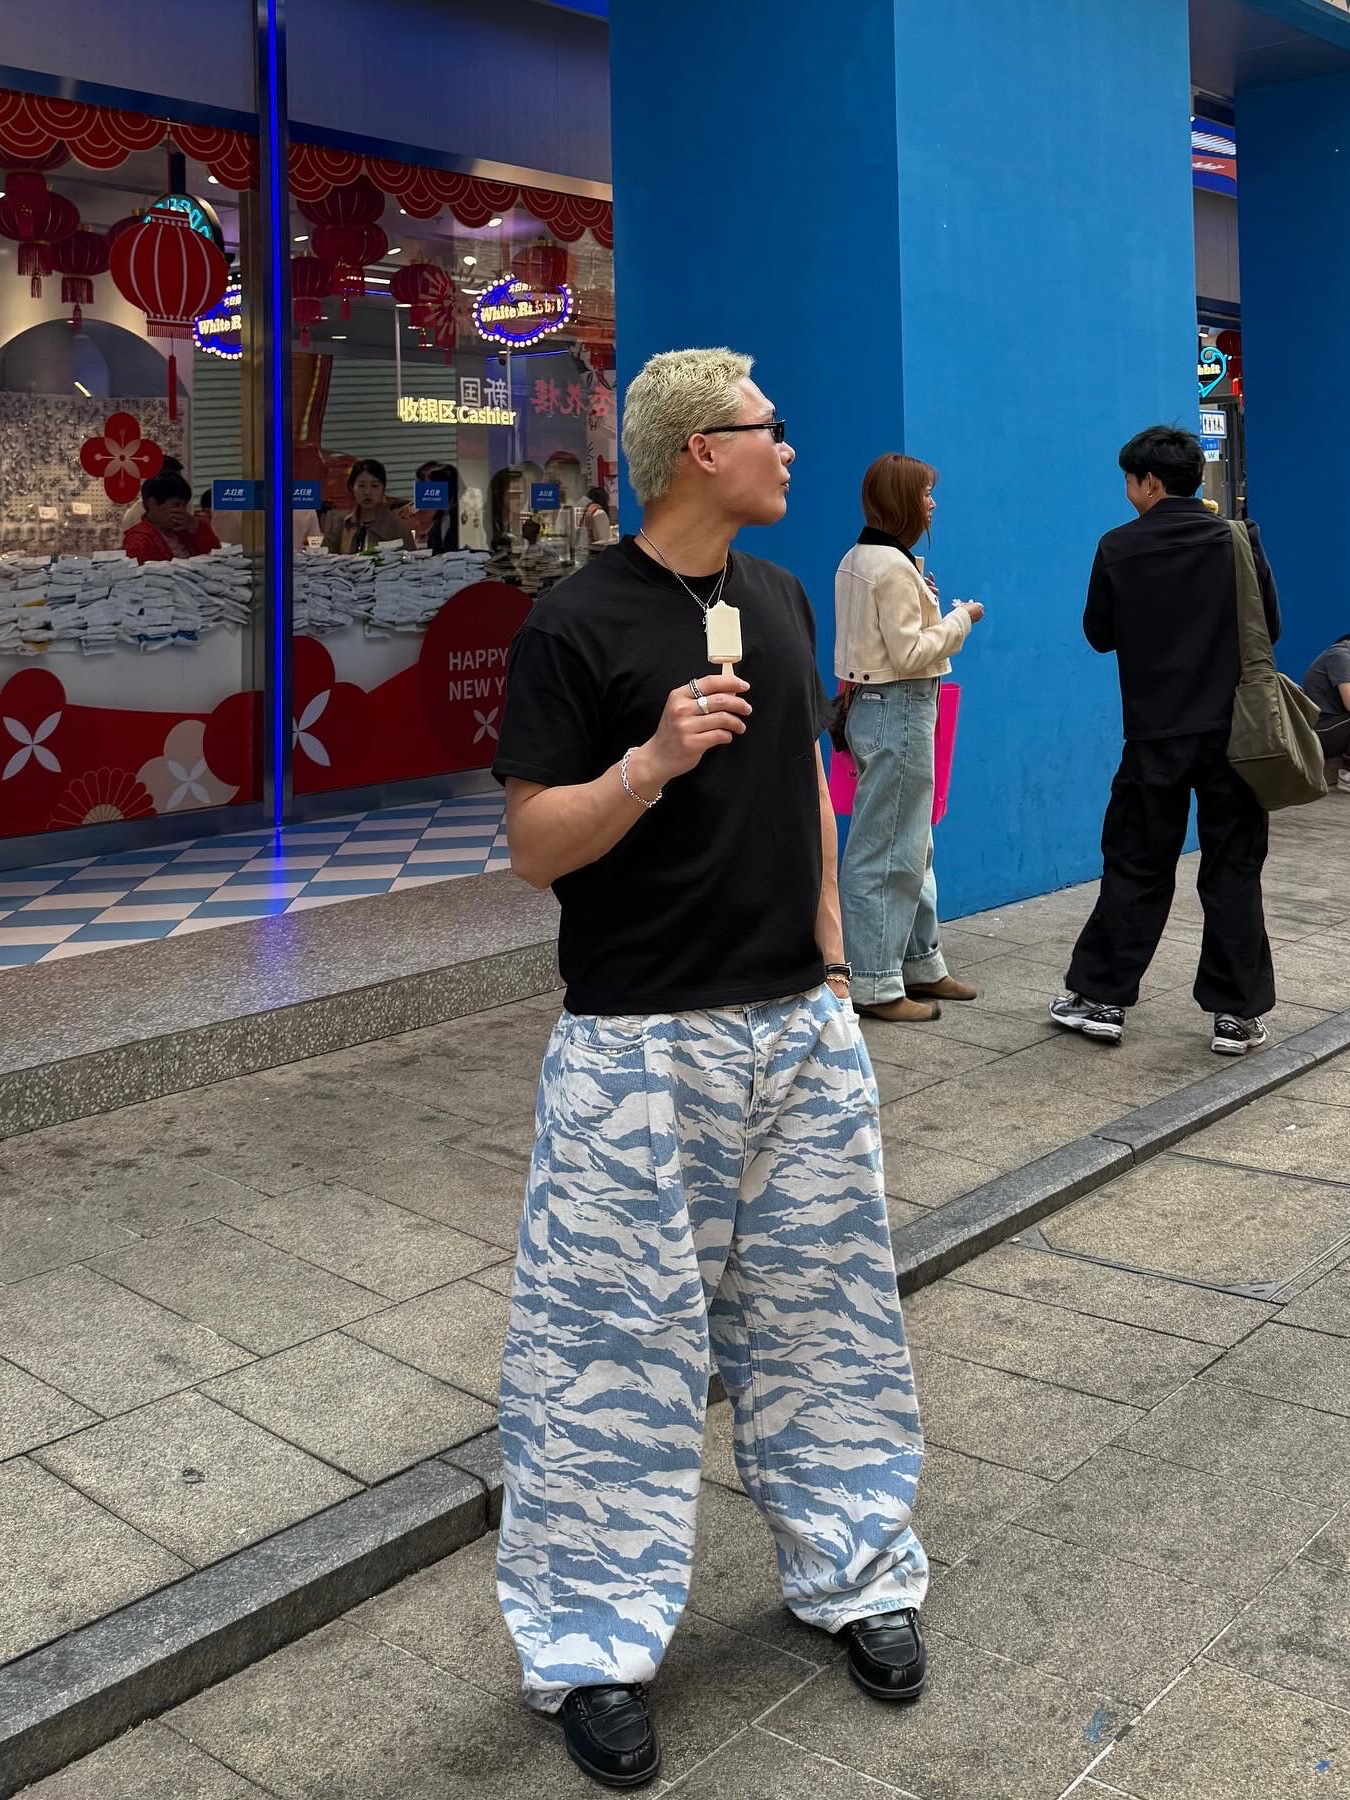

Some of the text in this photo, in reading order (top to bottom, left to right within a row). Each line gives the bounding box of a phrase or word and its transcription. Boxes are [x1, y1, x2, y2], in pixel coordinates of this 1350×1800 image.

[481, 305, 517, 322] White
[198, 318, 230, 335] White
[398, 396, 517, 425] 收银区 Cashier
[449, 648, 508, 671] HAPPY
[449, 678, 490, 701] NEW
